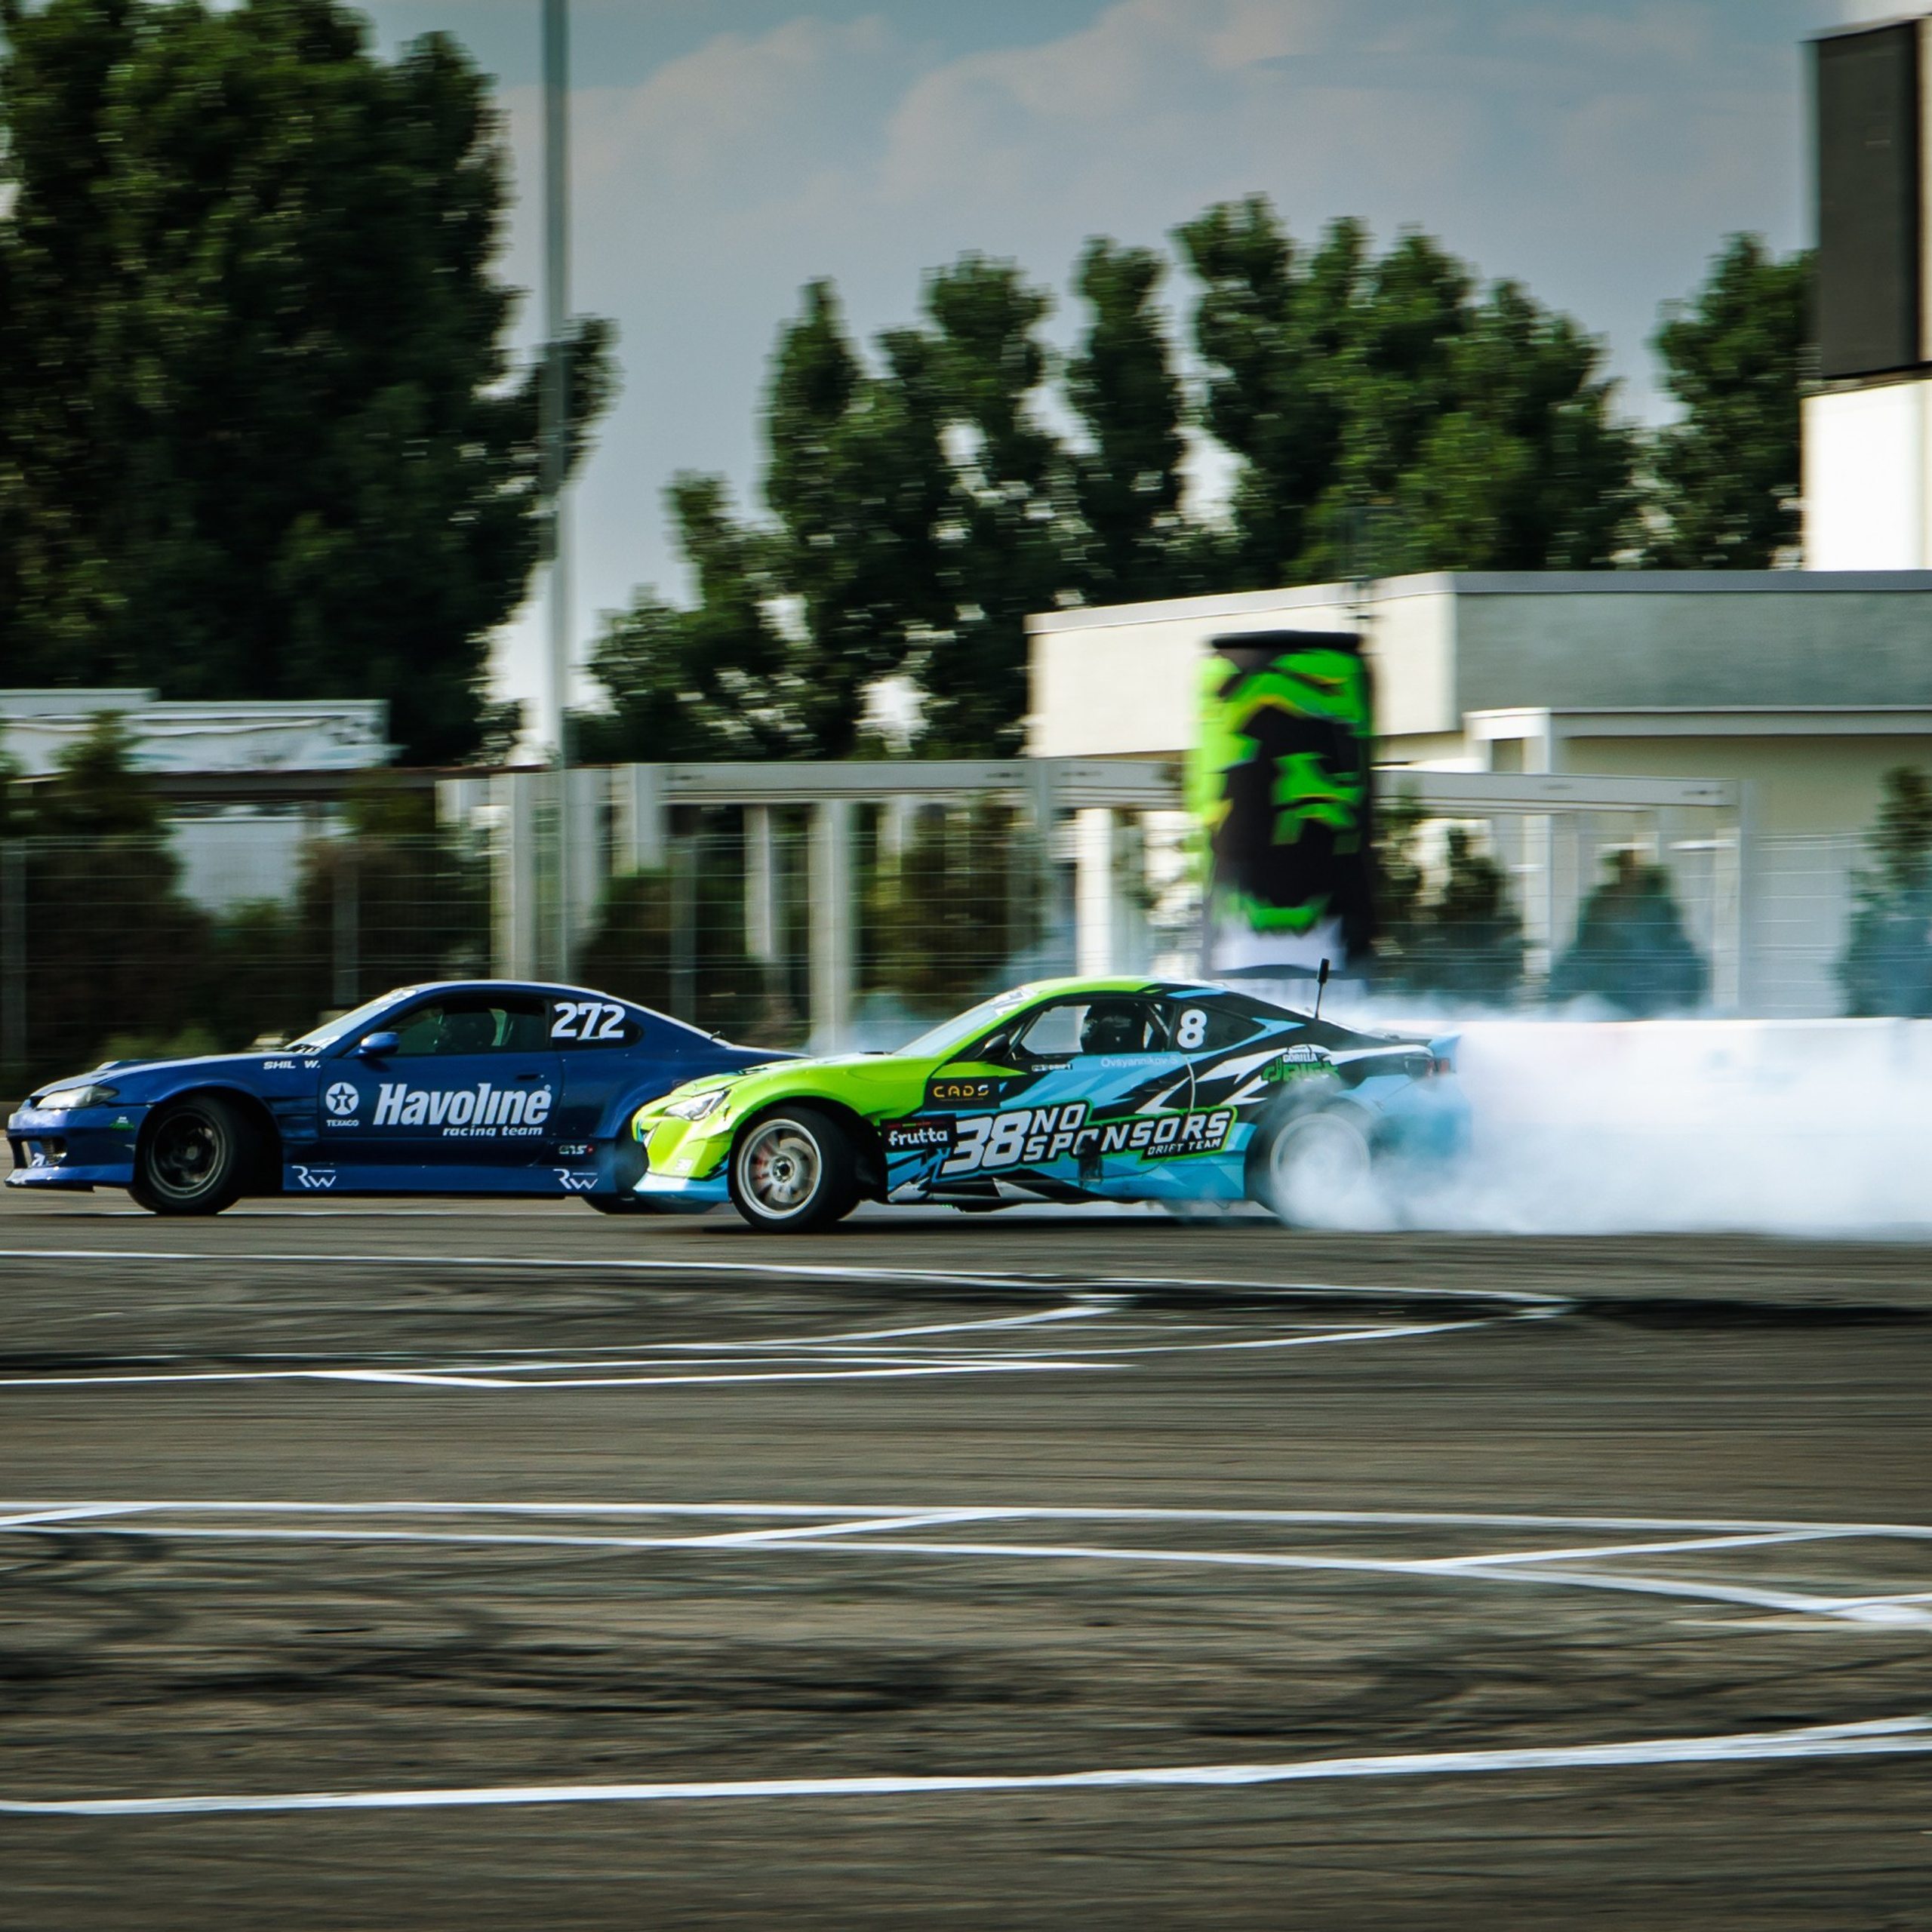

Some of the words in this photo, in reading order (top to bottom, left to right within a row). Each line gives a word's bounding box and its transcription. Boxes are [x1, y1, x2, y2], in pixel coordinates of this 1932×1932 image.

[551, 1002, 626, 1041] 272
[1177, 1009, 1208, 1048] 8
[263, 1060, 296, 1069] SHIL
[304, 1060, 321, 1069] W.
[934, 1084, 989, 1097] CADS
[373, 1083, 552, 1125] Havoline
[1031, 1103, 1086, 1134] NO
[443, 1124, 497, 1137] racing
[502, 1125, 543, 1136] team
[888, 1128, 949, 1146] frutta
[941, 1110, 1033, 1174] 38
[1147, 1143, 1184, 1156] DRIFT
[1189, 1137, 1222, 1151] TEAM
[291, 1165, 337, 1188] RW
[553, 1168, 598, 1189] RW
